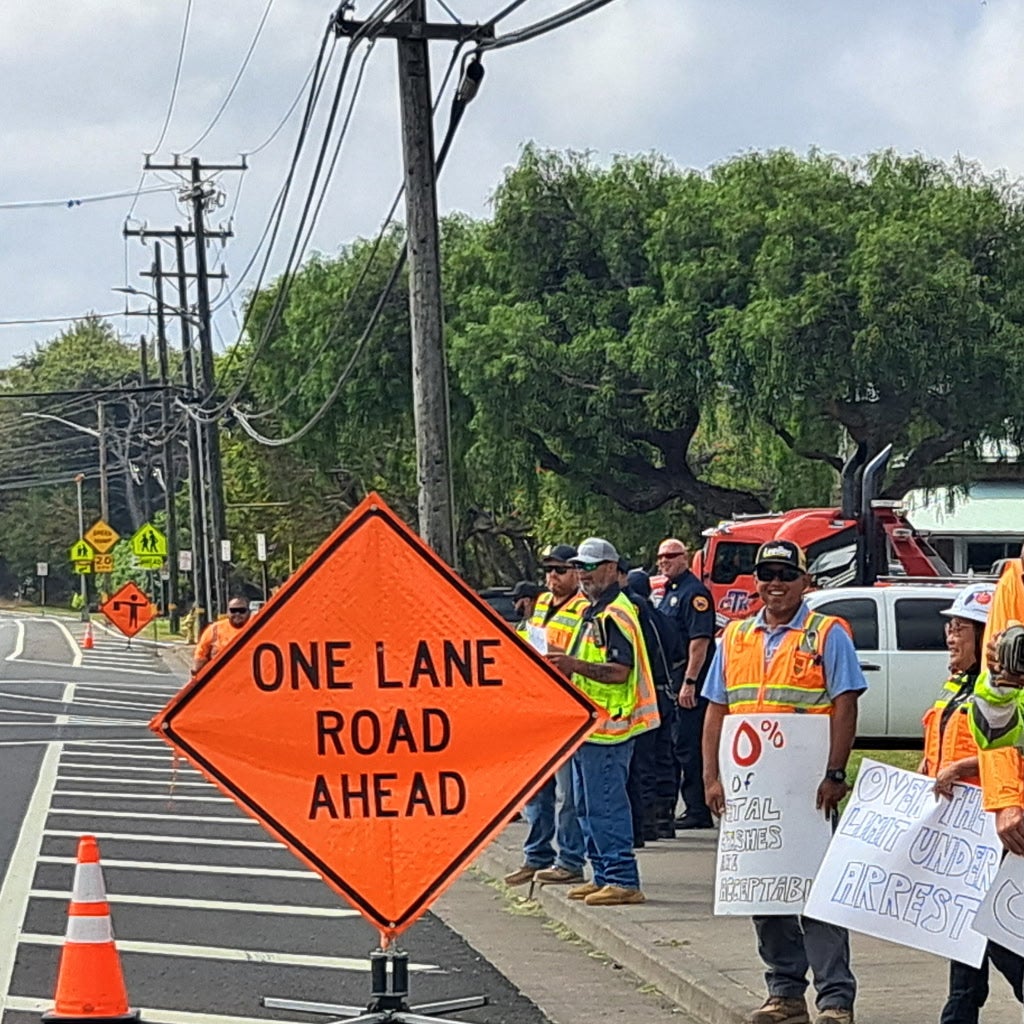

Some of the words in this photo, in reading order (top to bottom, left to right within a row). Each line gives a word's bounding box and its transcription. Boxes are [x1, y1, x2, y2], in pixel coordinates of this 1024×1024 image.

[253, 641, 353, 692] ONE
[376, 639, 503, 688] LANE
[316, 708, 451, 755] ROAD
[732, 720, 784, 767] 0%
[309, 771, 466, 819] AHEAD
[840, 808, 911, 852] LIMIT
[909, 826, 998, 892] UNDER
[831, 861, 983, 940] ARREST
